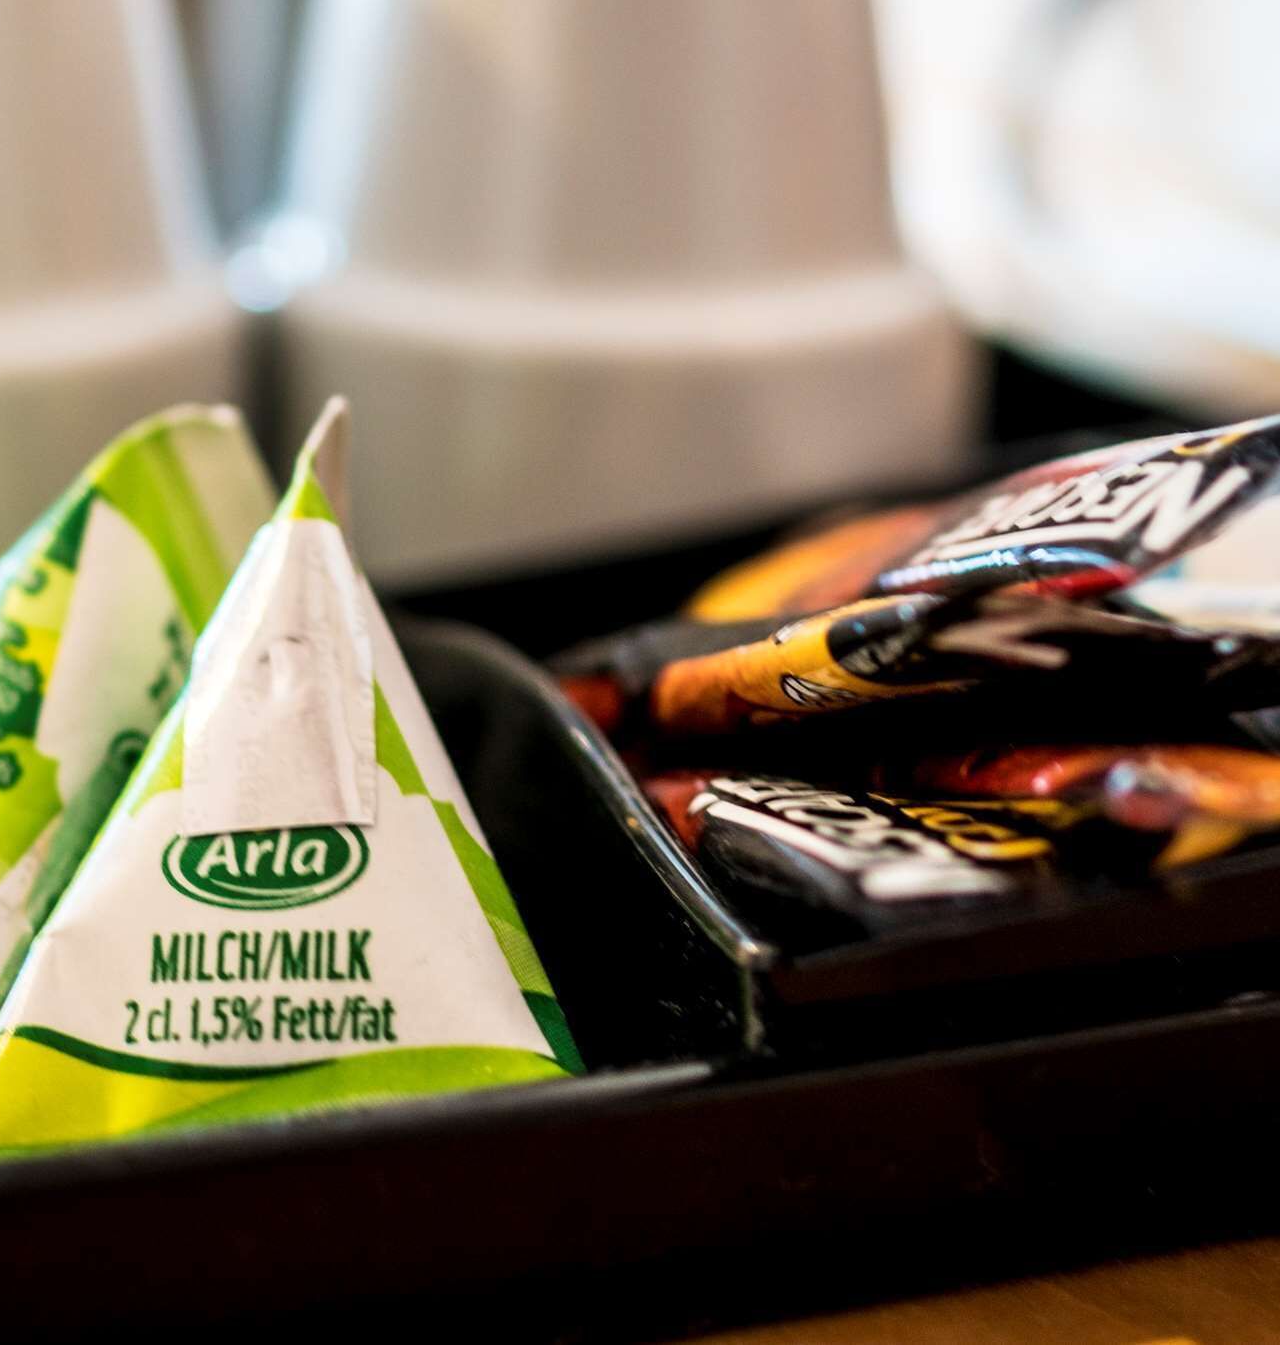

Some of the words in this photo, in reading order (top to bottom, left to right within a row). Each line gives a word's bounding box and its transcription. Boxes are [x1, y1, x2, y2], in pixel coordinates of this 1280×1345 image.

[195, 828, 329, 878] Arla
[150, 928, 373, 982] MILCH/MILK
[124, 999, 140, 1045] 2
[147, 997, 180, 1042] cl.
[189, 995, 263, 1047] 1,5%
[272, 994, 398, 1042] Fett/fat
